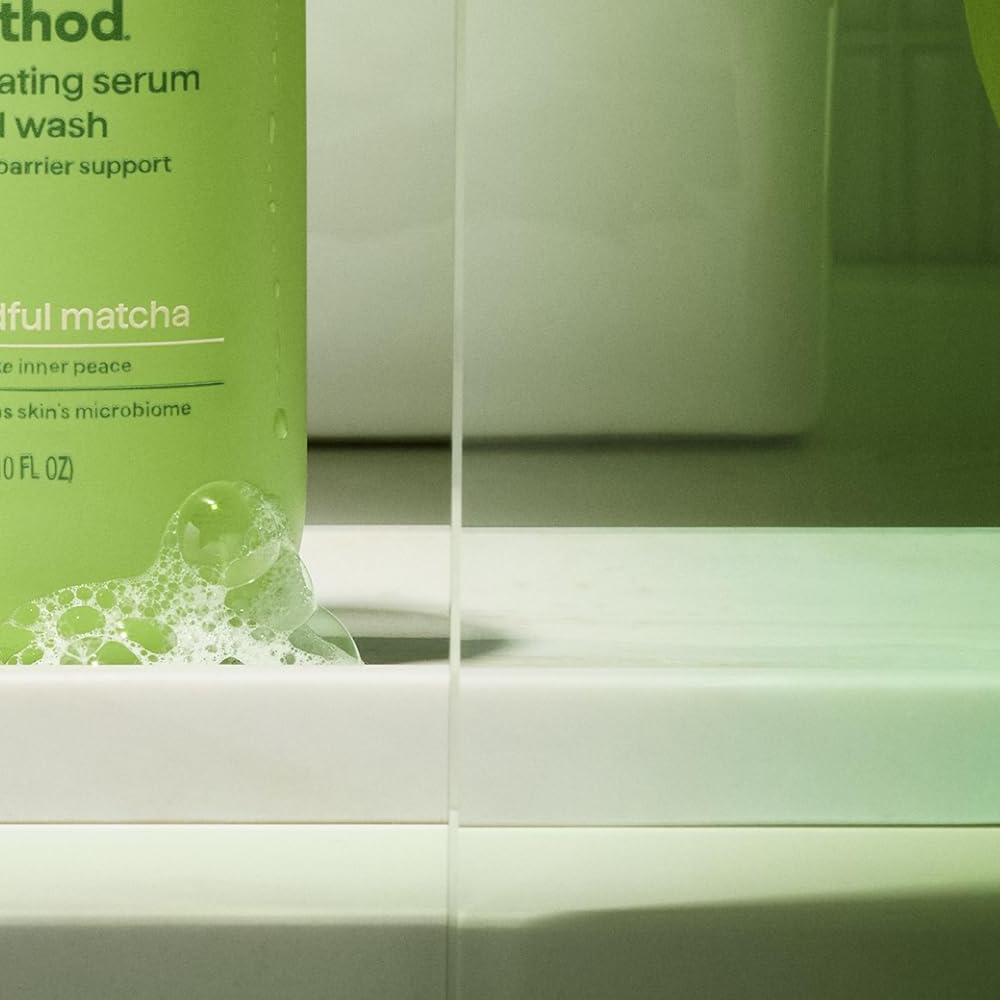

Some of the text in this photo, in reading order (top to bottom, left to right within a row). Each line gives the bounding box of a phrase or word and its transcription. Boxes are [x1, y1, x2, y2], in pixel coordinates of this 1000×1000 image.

[93, 69, 200, 95] serum
[15, 111, 108, 139] wash
[79, 156, 172, 180] support
[61, 300, 190, 331] matcha
[18, 358, 69, 375] inner
[73, 361, 132, 377] peace
[17, 403, 70, 420] skin's
[75, 401, 192, 419] microbiome
[20, 456, 40, 480] FL
[45, 456, 74, 484] OZ)
